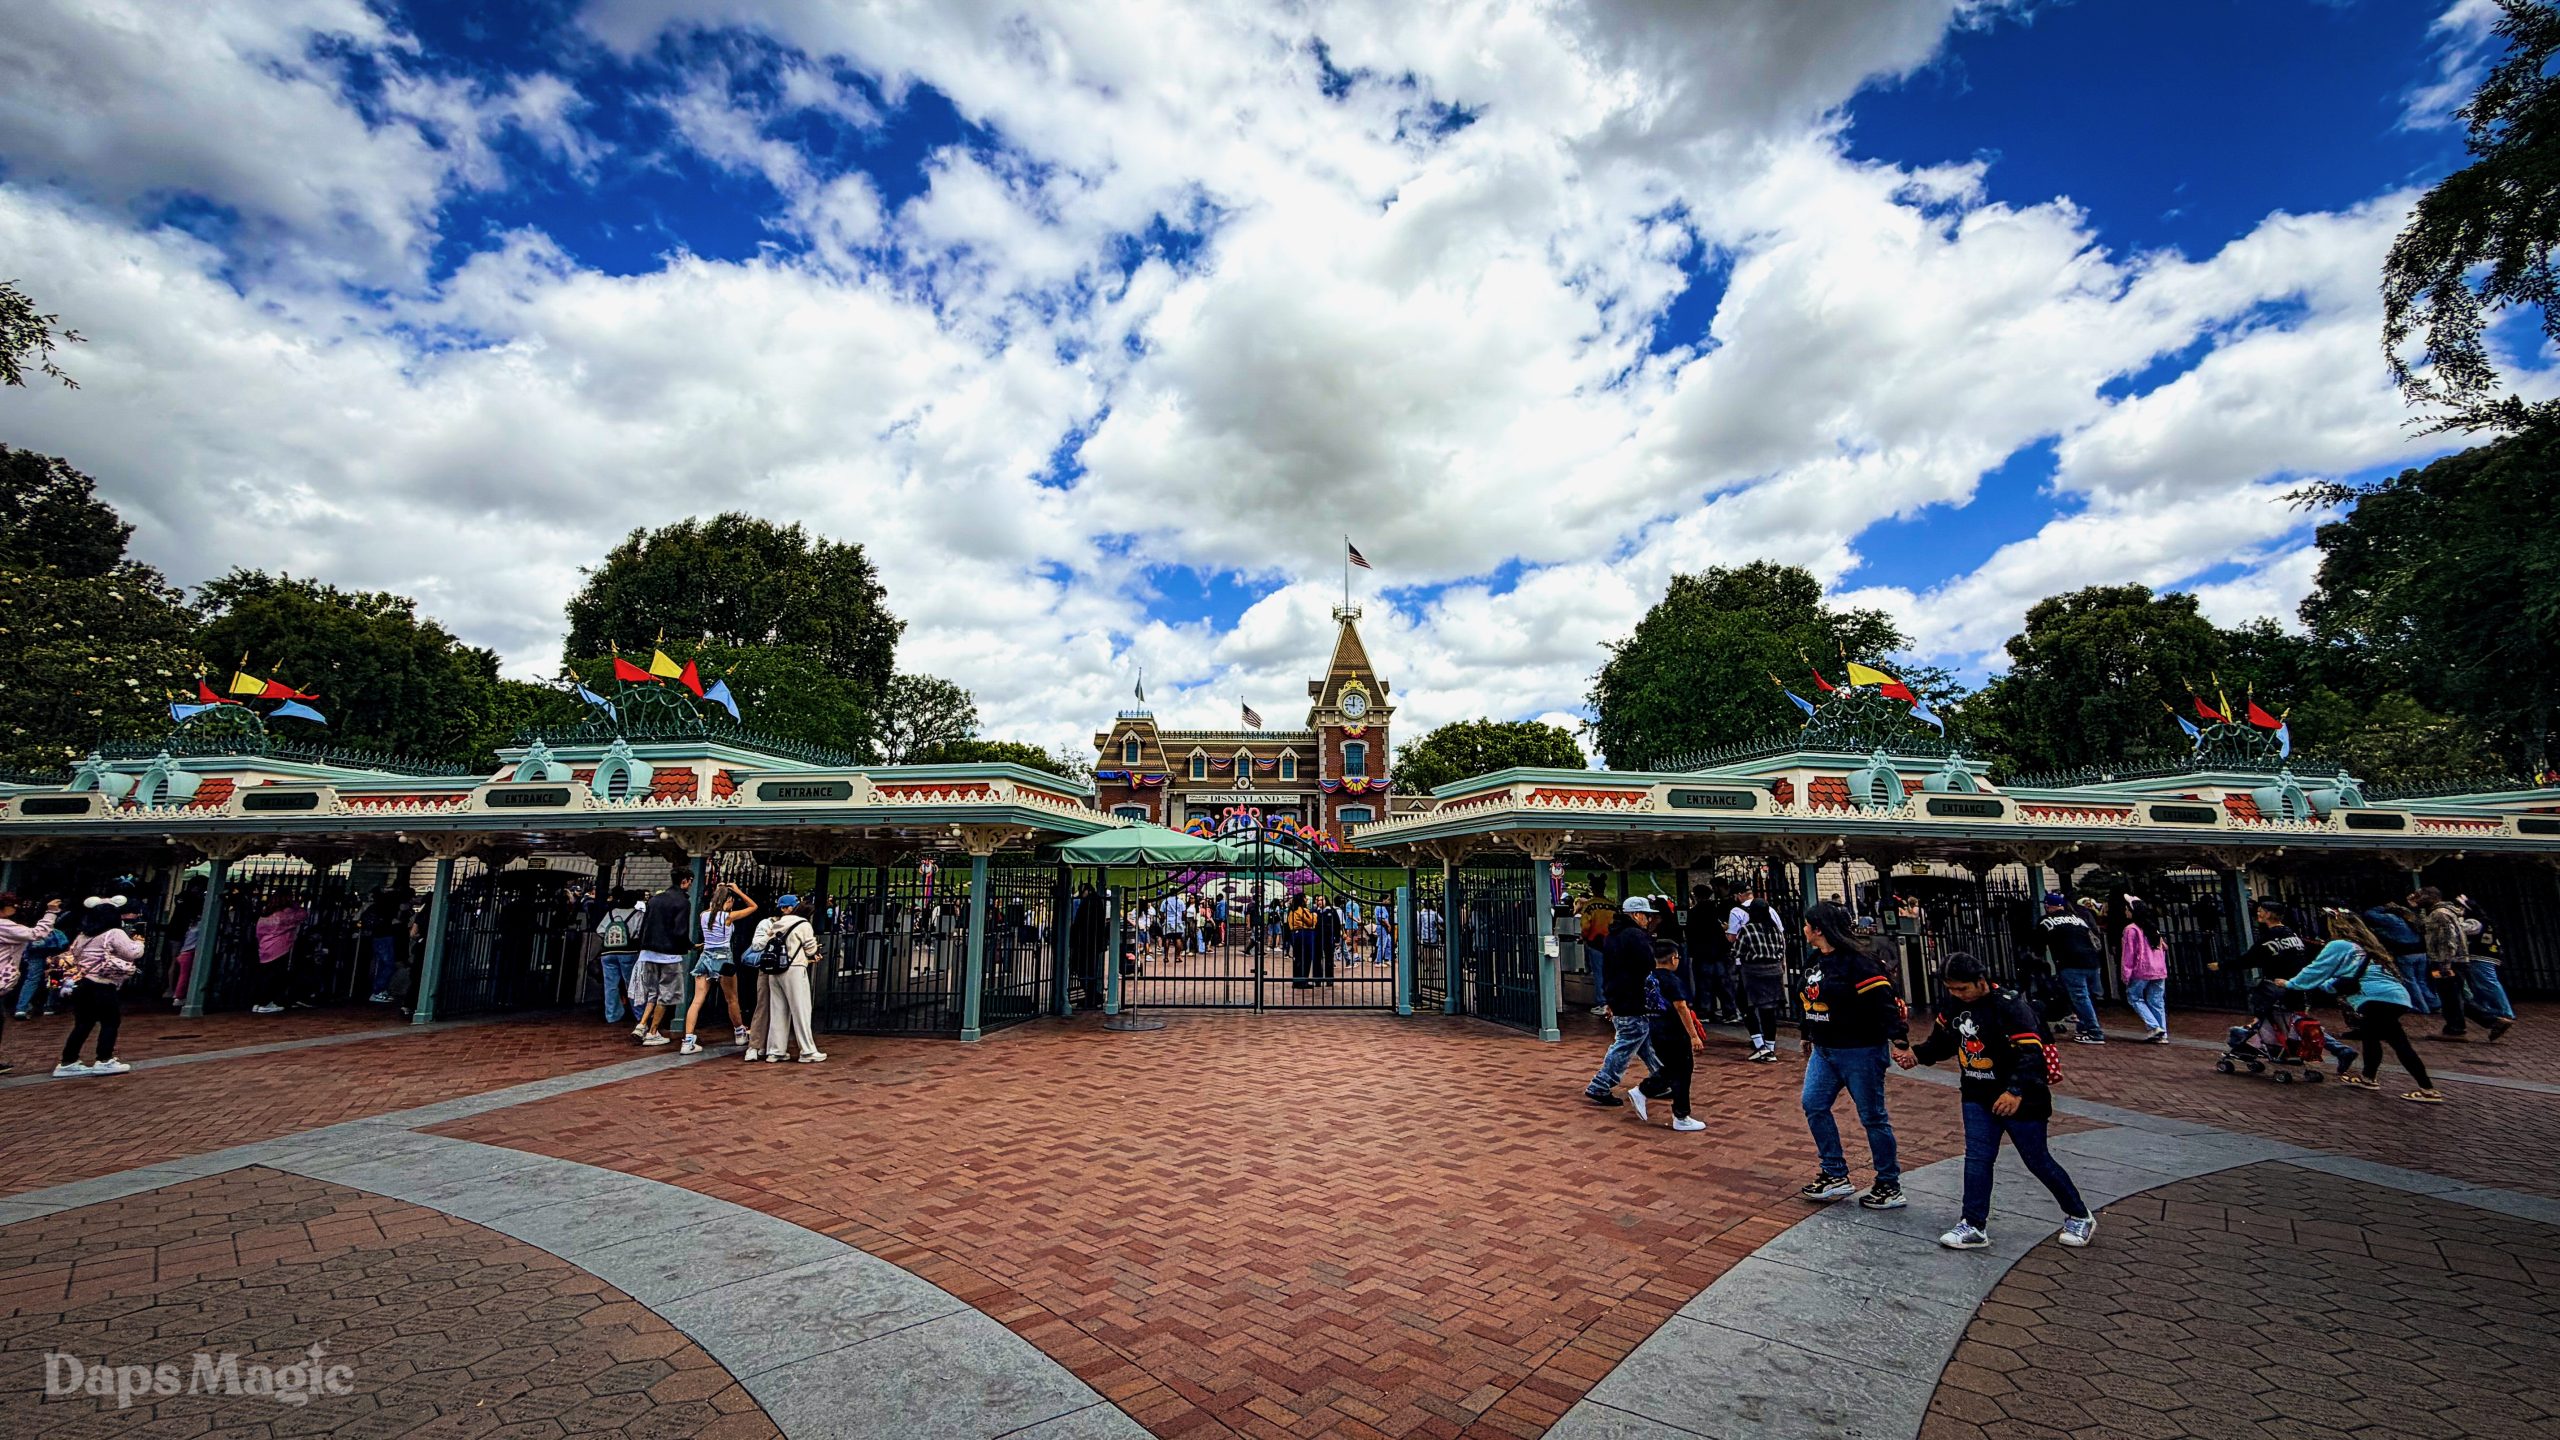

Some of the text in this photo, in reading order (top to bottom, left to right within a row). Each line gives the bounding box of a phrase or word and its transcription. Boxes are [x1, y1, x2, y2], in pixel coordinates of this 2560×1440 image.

[778, 787, 833, 798] ENTRANCE
[260, 797, 304, 807] ENTRANCE
[505, 793, 553, 804] ENTRANCE
[1210, 795, 1280, 803] DISNEYLAND
[1686, 794, 1737, 806] ENTRANCE
[1942, 803, 1986, 814] ENTRANCE
[2162, 810, 2201, 820] ENTRANCE
